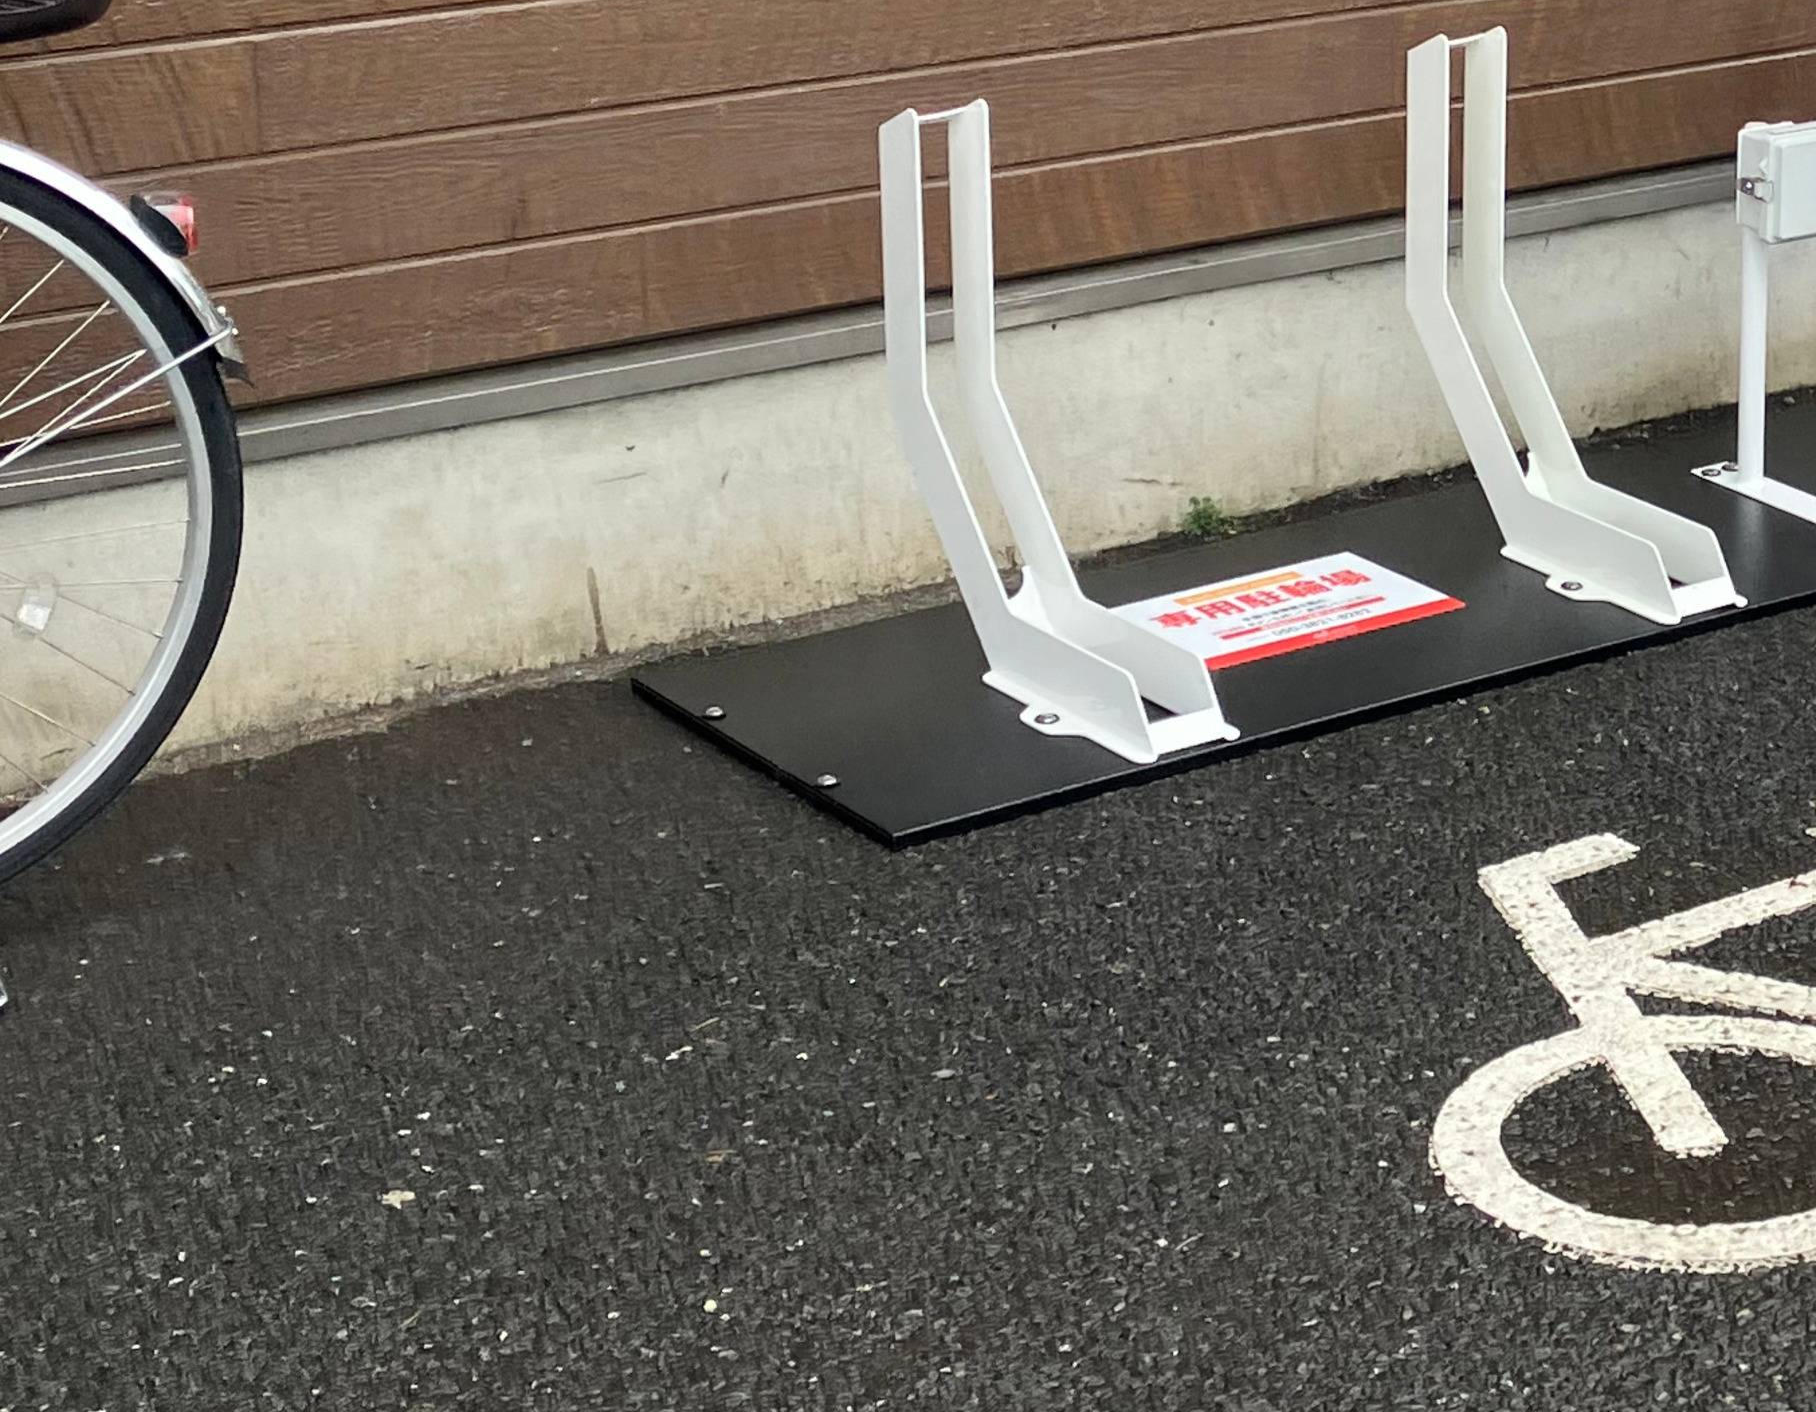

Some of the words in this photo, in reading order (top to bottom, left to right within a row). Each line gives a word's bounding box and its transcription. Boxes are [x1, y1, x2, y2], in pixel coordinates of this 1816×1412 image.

[1150, 568, 1372, 630] 専用駐輪場
